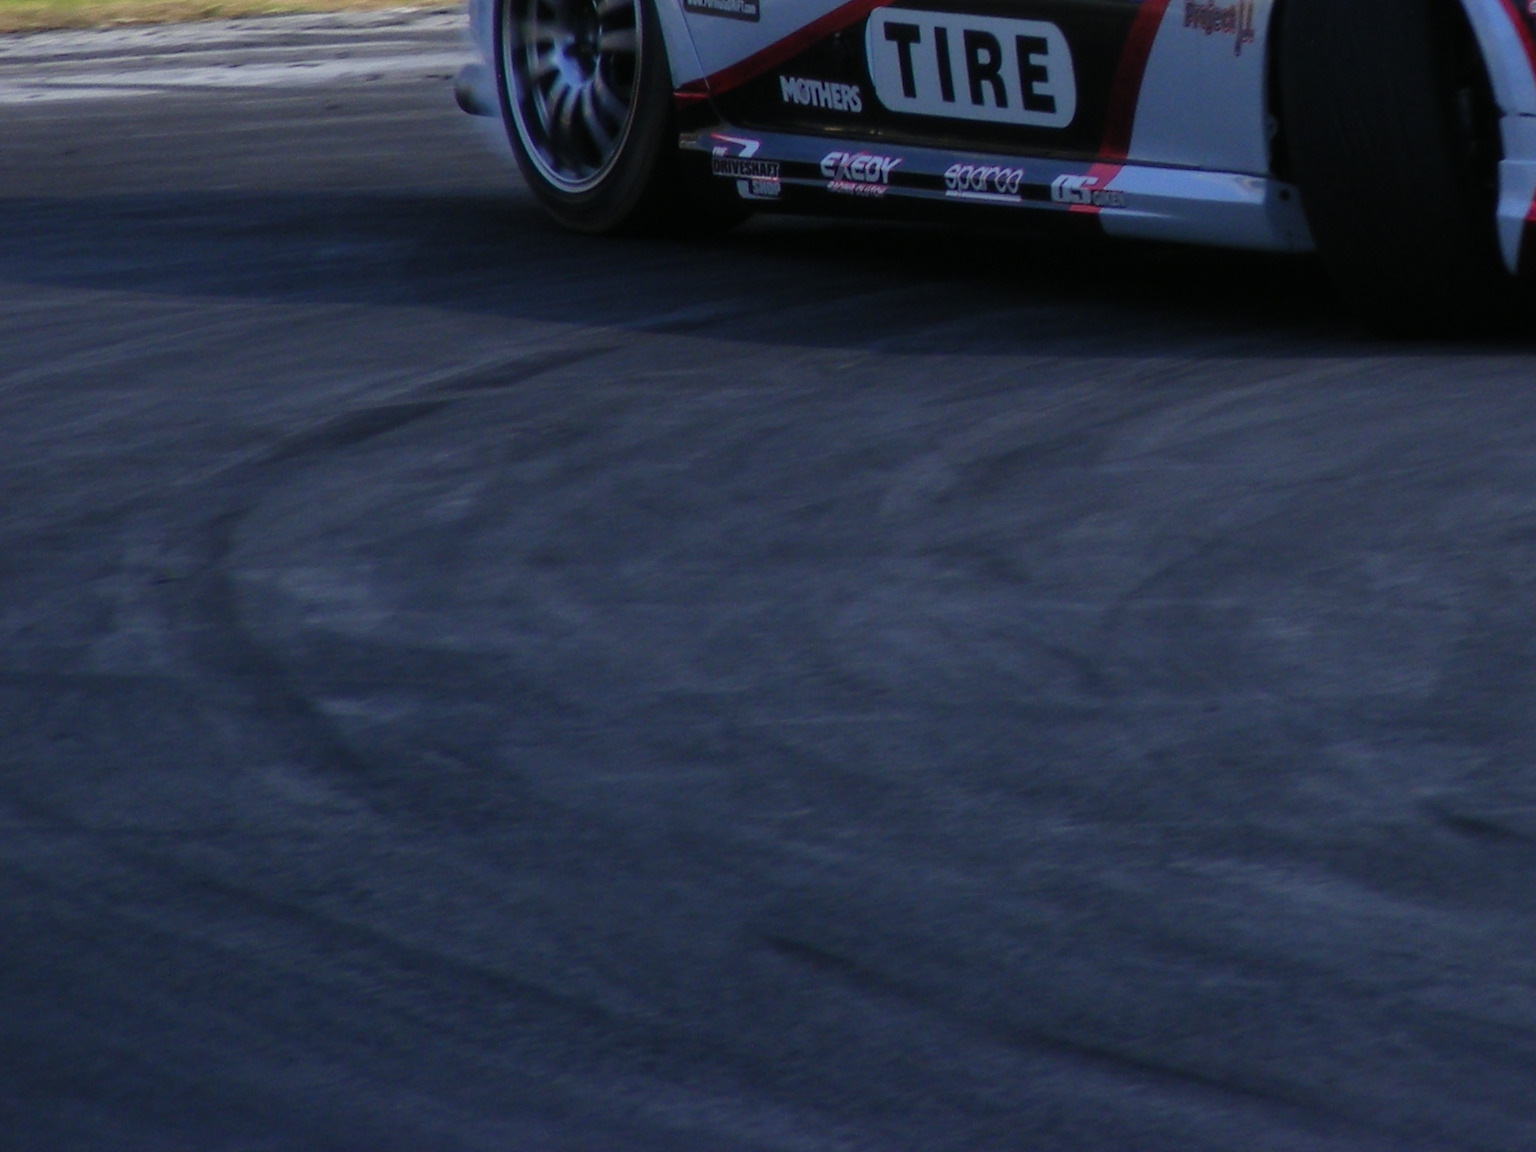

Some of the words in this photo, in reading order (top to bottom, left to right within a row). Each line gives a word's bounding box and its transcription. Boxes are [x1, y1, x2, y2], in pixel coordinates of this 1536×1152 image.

[883, 21, 1057, 114] TIRE
[779, 75, 863, 114] MOTHERS
[712, 157, 780, 179] DRIVESHAFT
[819, 150, 902, 185] EXEDY
[944, 163, 1024, 198] sparco
[751, 180, 782, 198] SHOP
